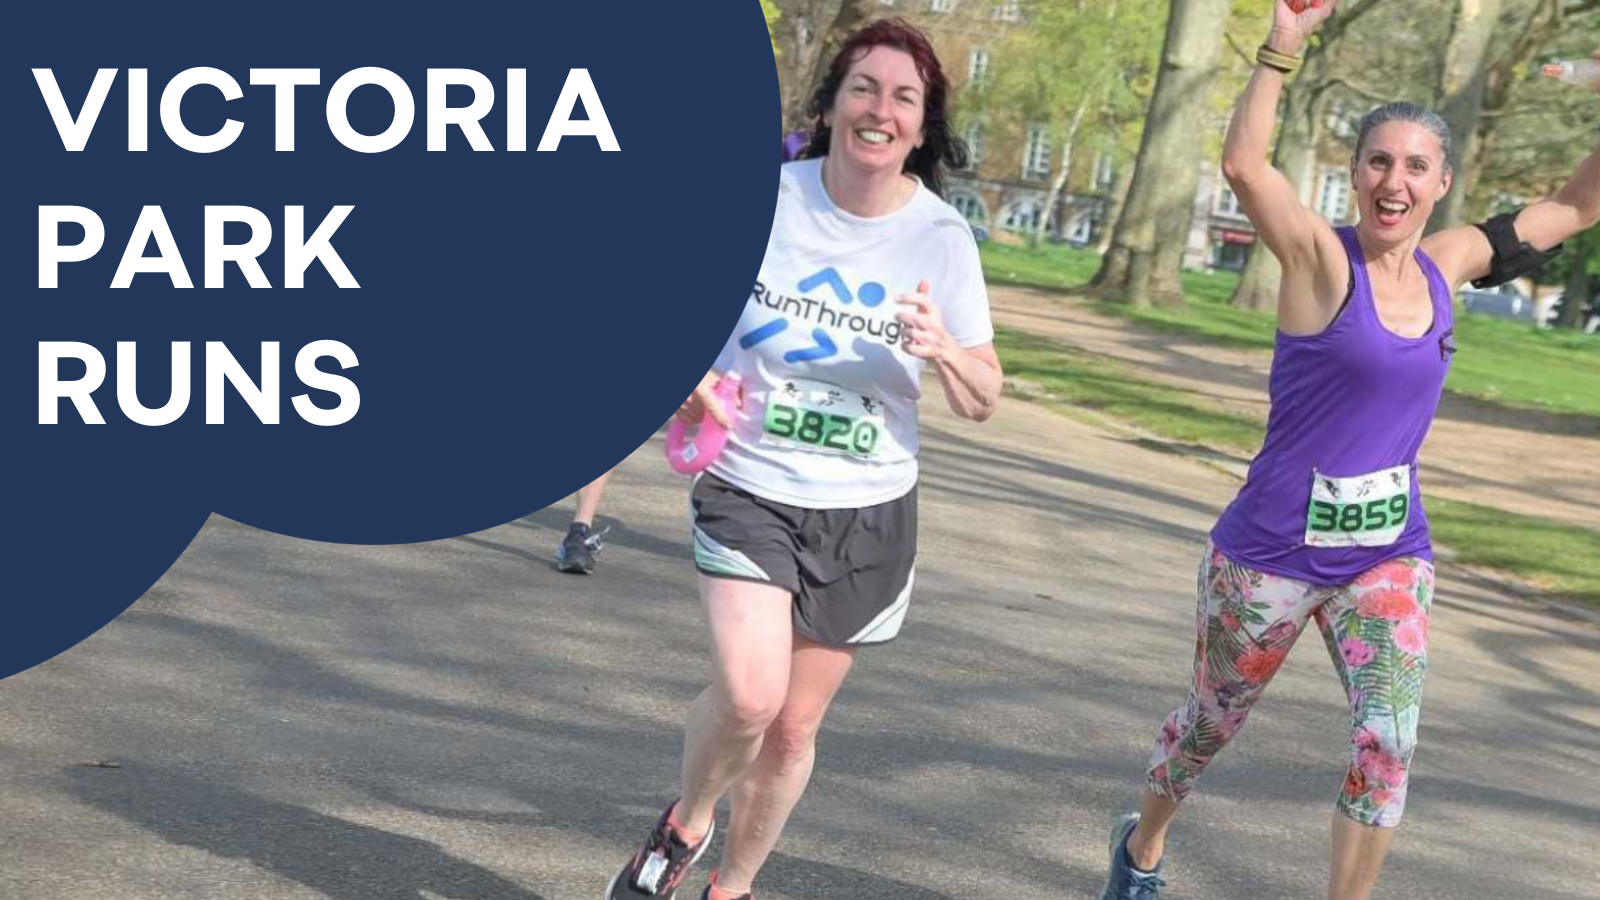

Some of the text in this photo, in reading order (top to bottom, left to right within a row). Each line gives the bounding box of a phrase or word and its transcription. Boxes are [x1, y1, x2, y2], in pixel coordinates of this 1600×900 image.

[752, 280, 912, 346] RunThroug
[768, 404, 879, 455] 3820
[1310, 493, 1408, 532] 3859
